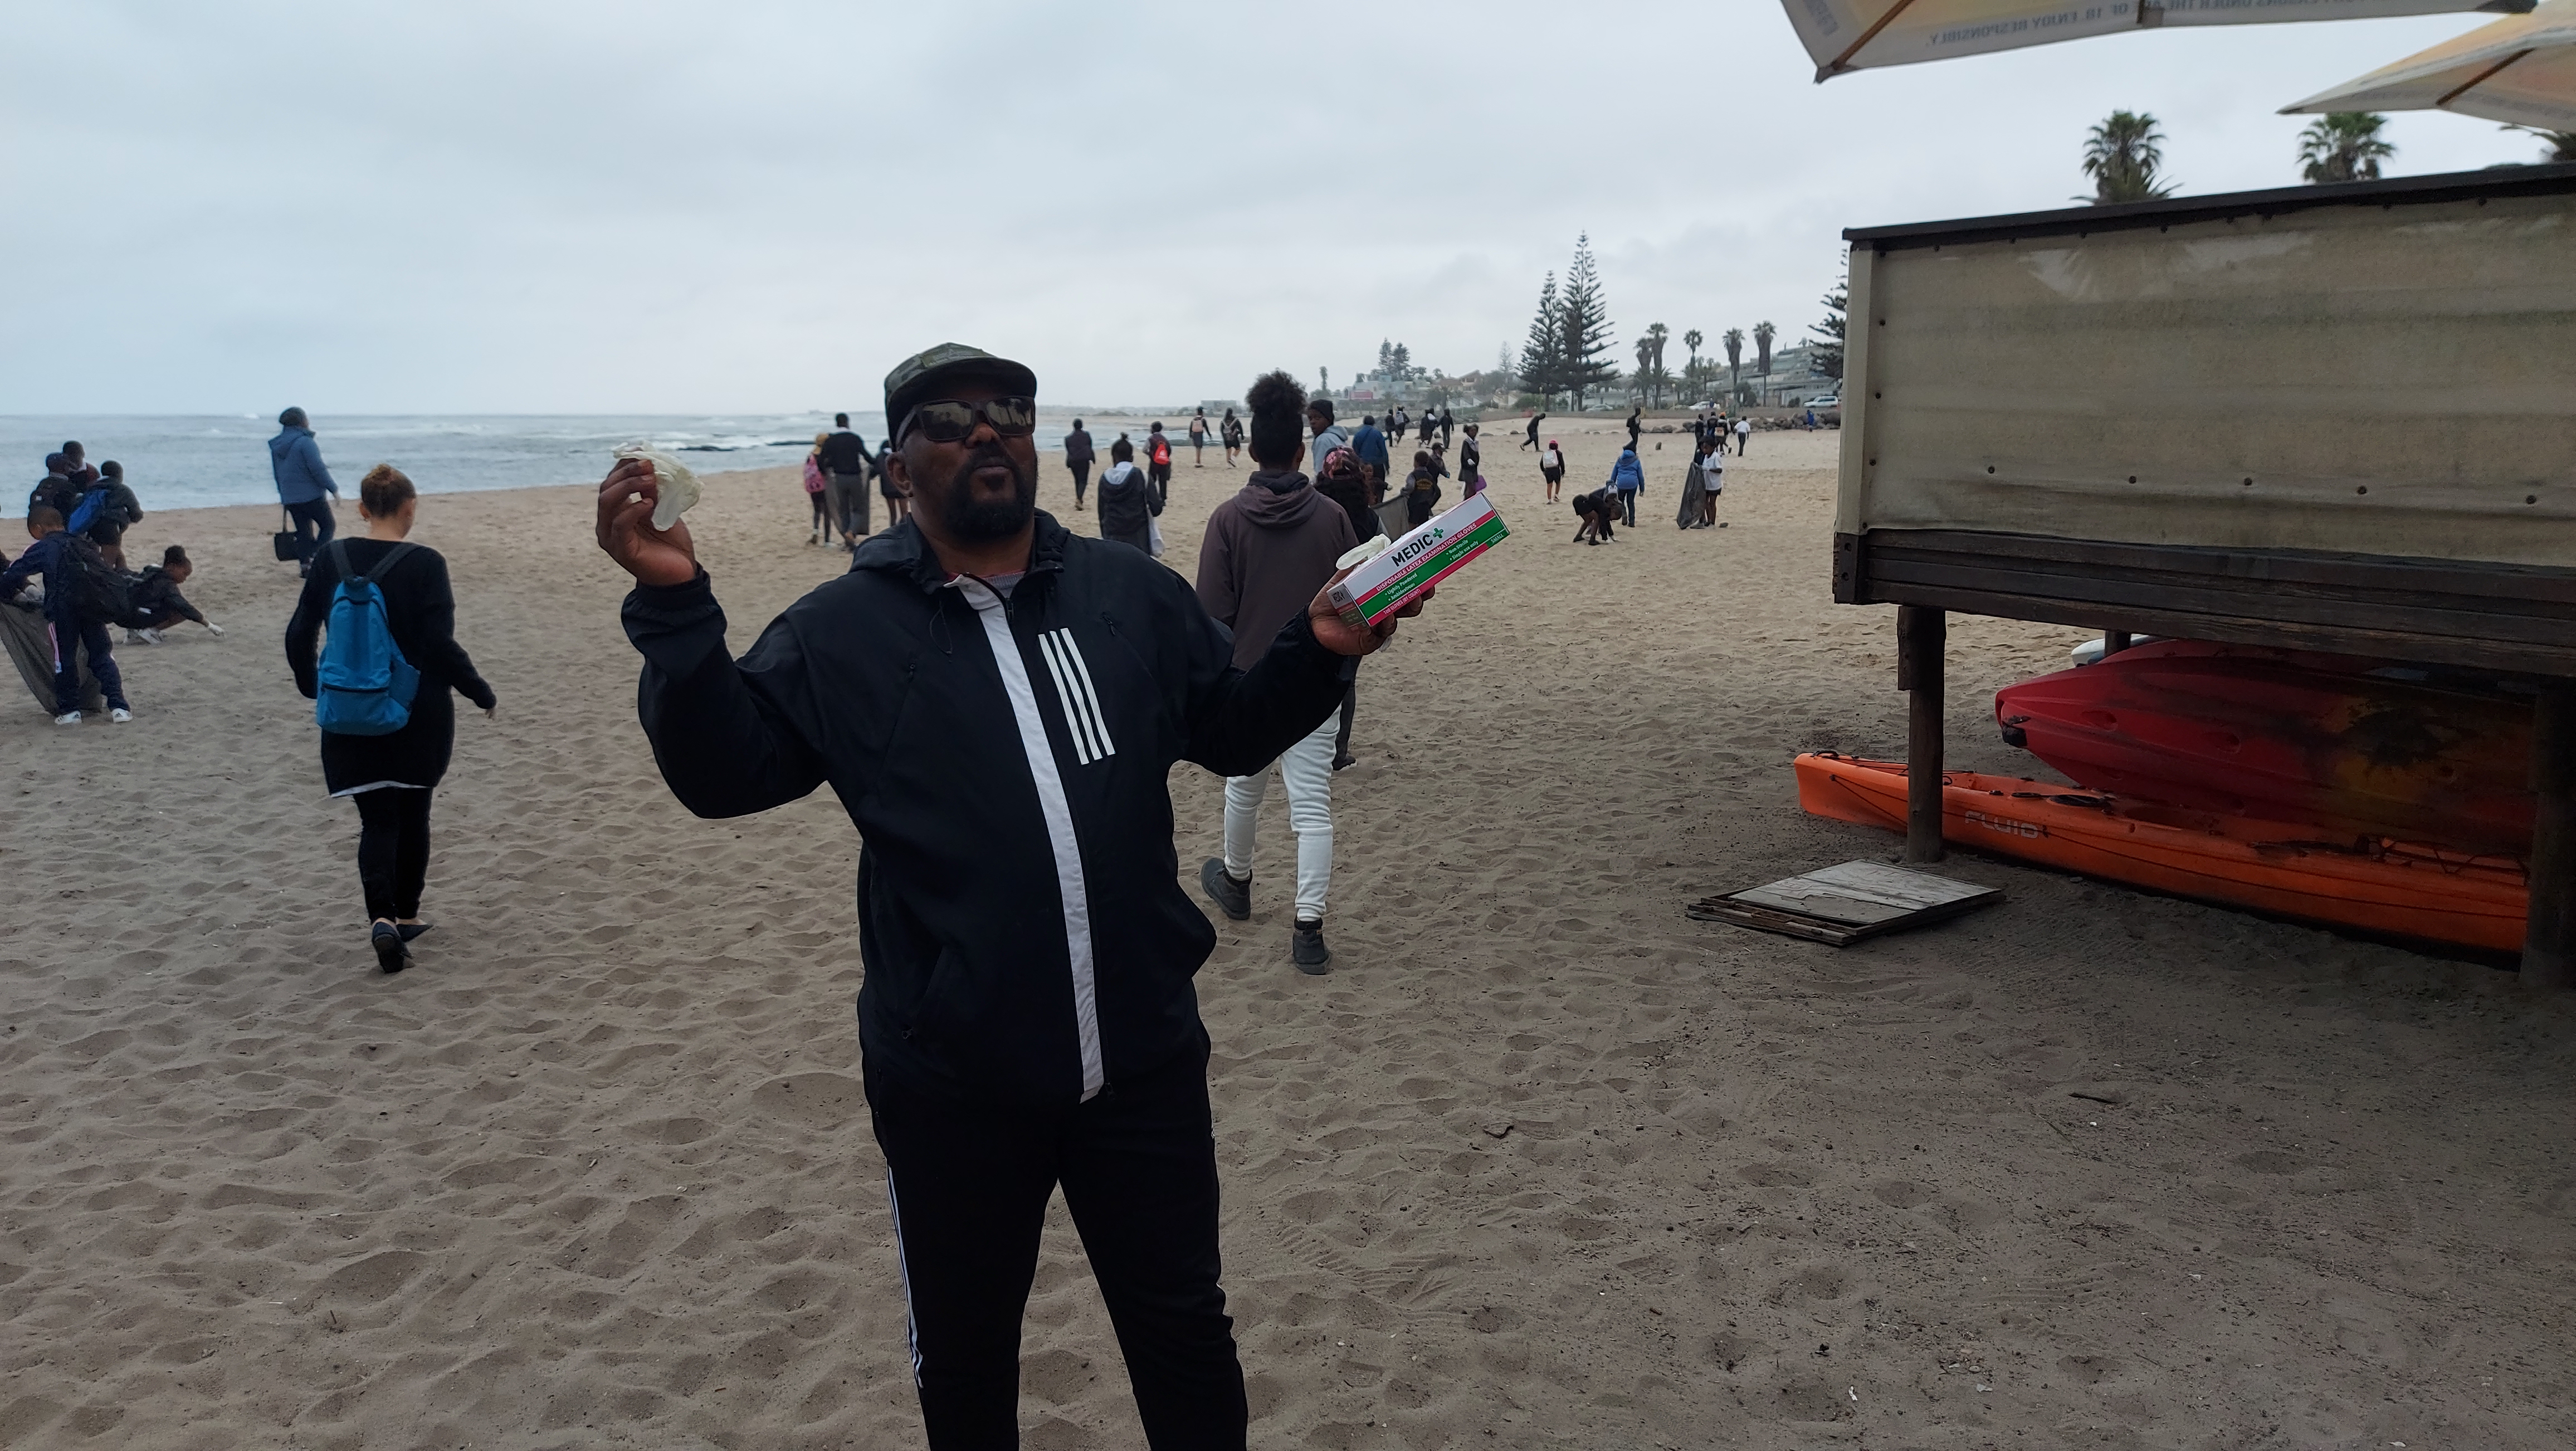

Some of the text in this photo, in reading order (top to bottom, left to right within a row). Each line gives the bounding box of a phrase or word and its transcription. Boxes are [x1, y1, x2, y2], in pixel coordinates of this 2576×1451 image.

[1451, 549, 1464, 560] Single
[1470, 539, 1479, 548] only
[1490, 533, 1504, 544] SMALL
[1375, 522, 1477, 592] DISPOSABLE LATEX EXAMINATION GLOVES
[1387, 572, 1418, 595] Lightly Powdered
[1965, 810, 2038, 839] FLUID
